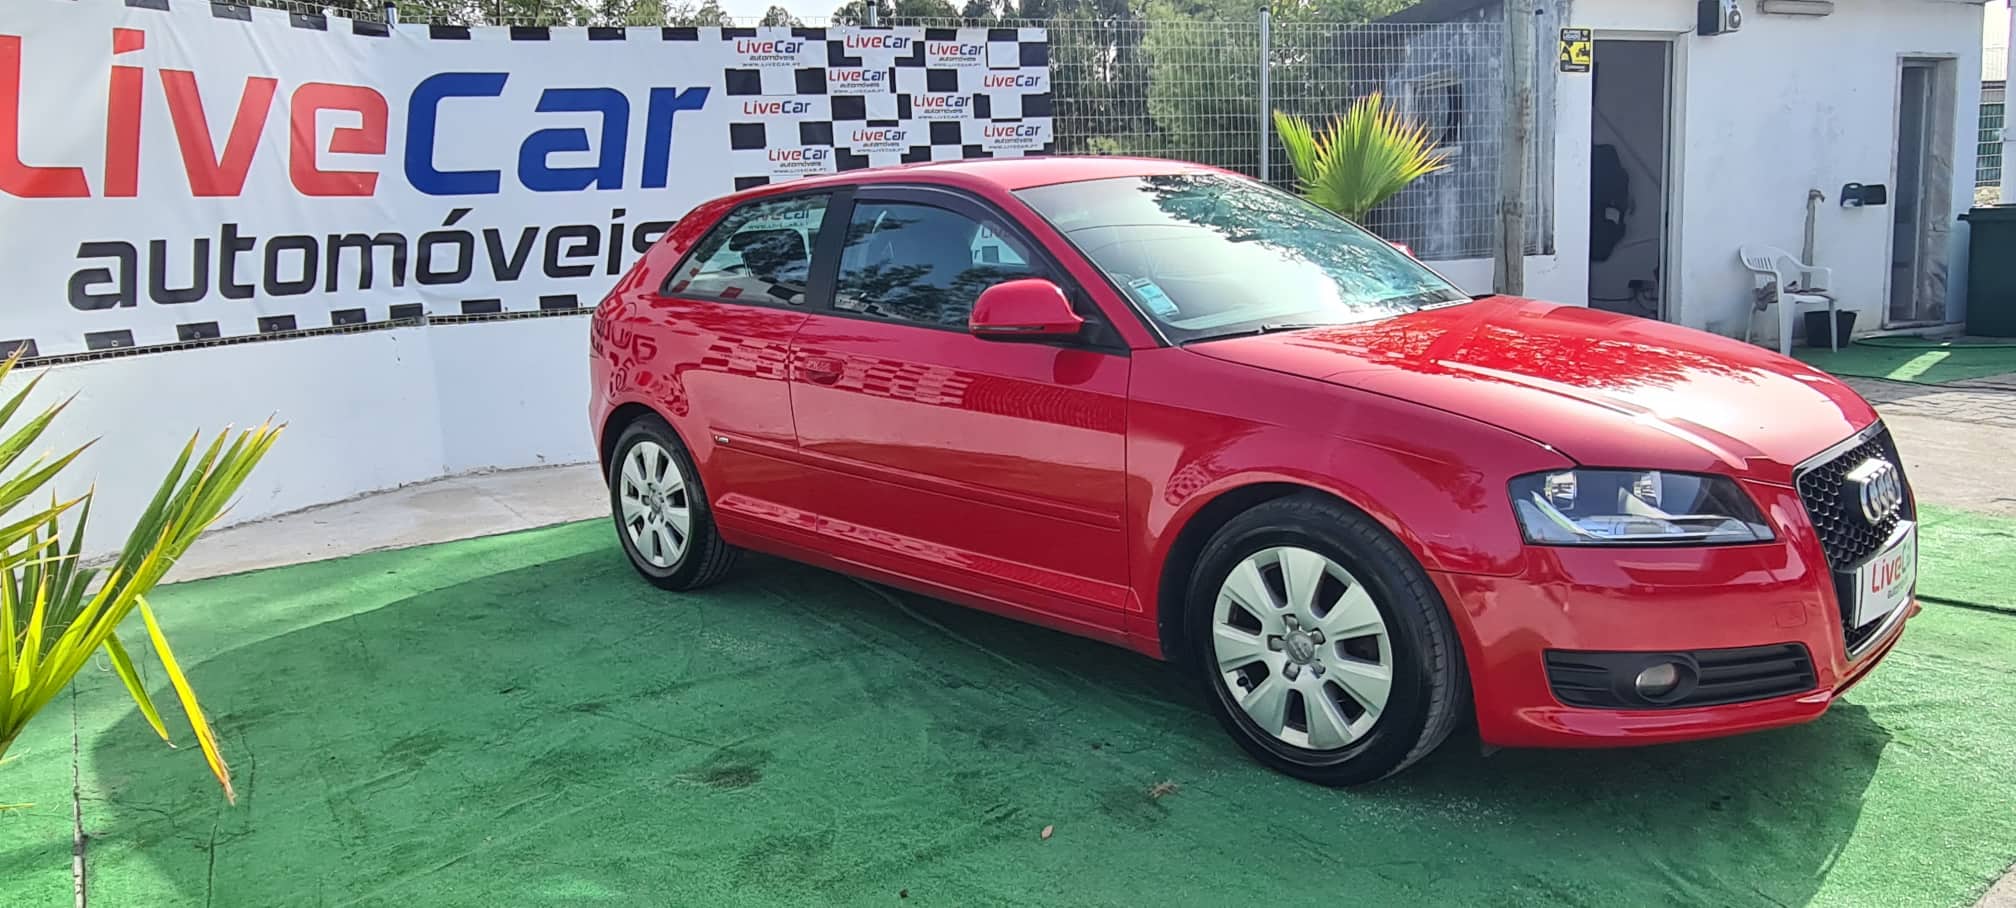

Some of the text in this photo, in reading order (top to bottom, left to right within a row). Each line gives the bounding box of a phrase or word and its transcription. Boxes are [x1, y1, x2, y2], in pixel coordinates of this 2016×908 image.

[737, 40, 804, 54] LiveCar
[846, 34, 911, 49] LiveCar
[929, 42, 984, 56] LiveCar
[829, 68, 888, 82] LiveCar
[984, 75, 1041, 88] LiveCar
[744, 100, 811, 115] LiveCar
[913, 94, 971, 107] LiveCar
[0, 27, 711, 198] LiveCar
[852, 129, 907, 142] LiveCar
[984, 125, 1041, 137] LiveCar
[769, 148, 829, 162] LiveCar
[67, 208, 678, 311] automóveis
